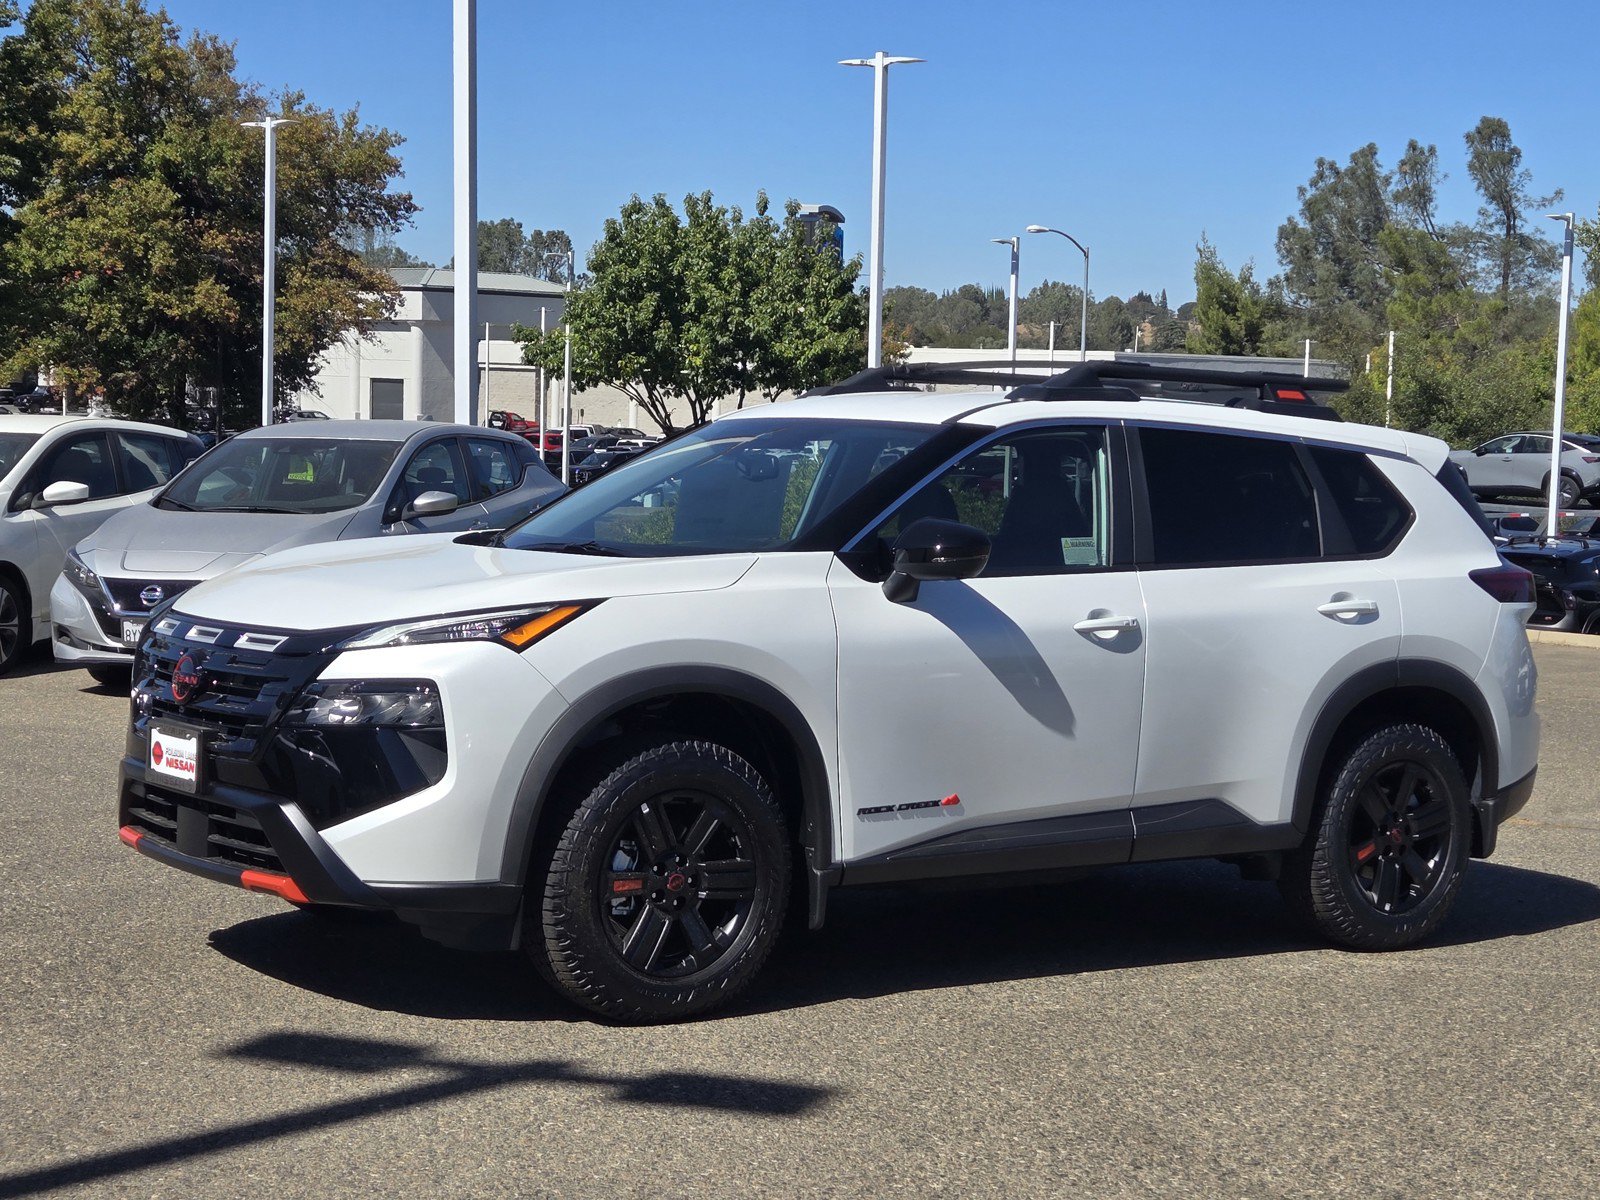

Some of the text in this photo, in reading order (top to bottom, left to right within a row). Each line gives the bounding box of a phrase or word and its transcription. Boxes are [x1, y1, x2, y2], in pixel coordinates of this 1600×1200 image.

[166, 757, 195, 773] NISSAN
[857, 800, 941, 816] ROCK CREEK
